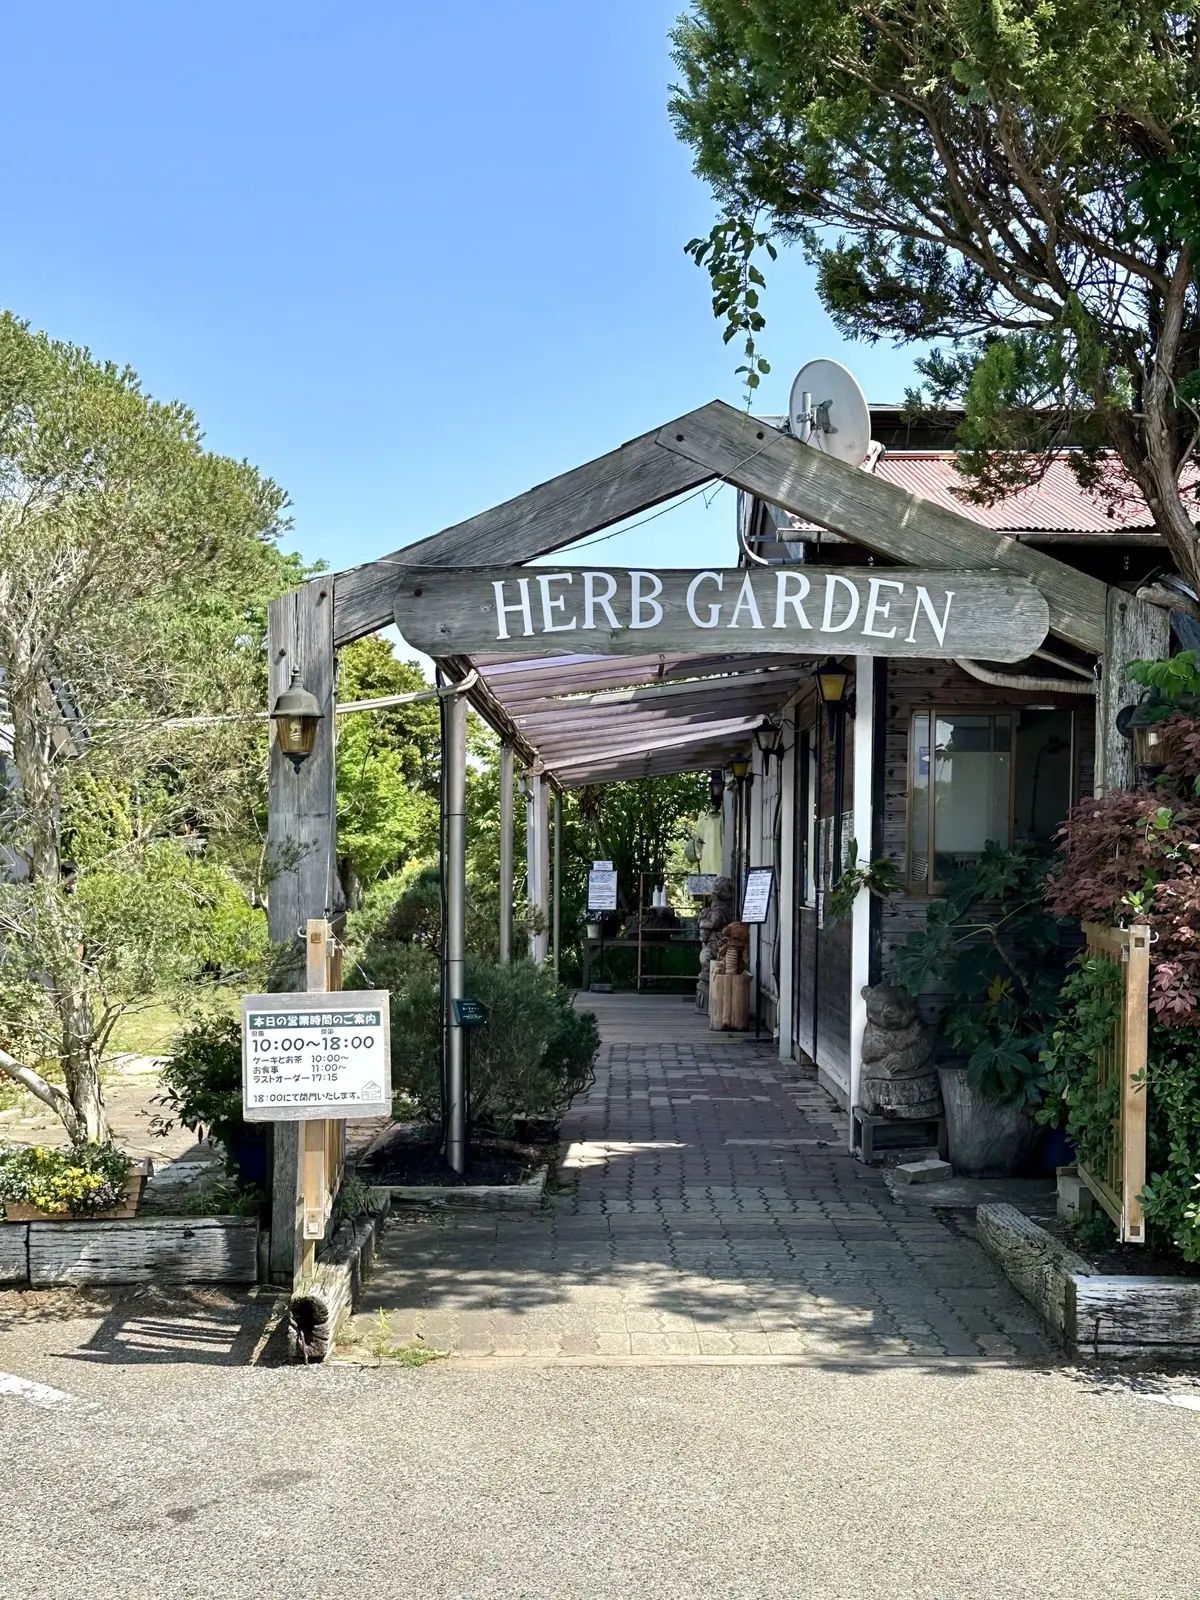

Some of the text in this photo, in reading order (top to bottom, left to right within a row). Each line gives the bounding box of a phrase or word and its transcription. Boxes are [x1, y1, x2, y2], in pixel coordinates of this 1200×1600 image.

[491, 569, 956, 648] HERB GARDEN
[253, 1014, 377, 1027] 本日の営業時間のご案内
[252, 1055, 303, 1064] ケーキとお茶
[252, 1065, 280, 1075] お食事
[252, 1073, 339, 1084] ラストオーダー 17:15
